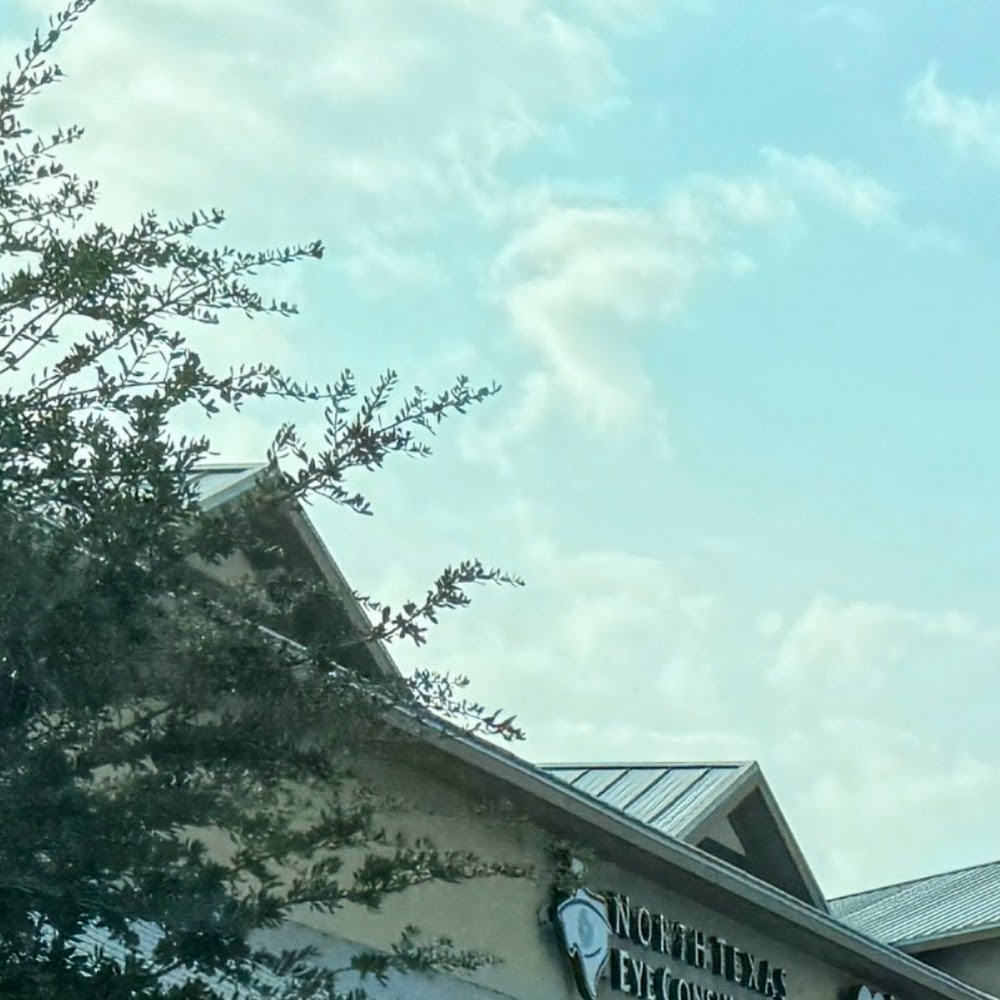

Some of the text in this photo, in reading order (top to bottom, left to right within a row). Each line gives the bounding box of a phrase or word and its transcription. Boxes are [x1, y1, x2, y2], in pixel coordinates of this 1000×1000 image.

[614, 892, 788, 1000] NORTH TEXAS
[618, 949, 656, 1000] EYE
